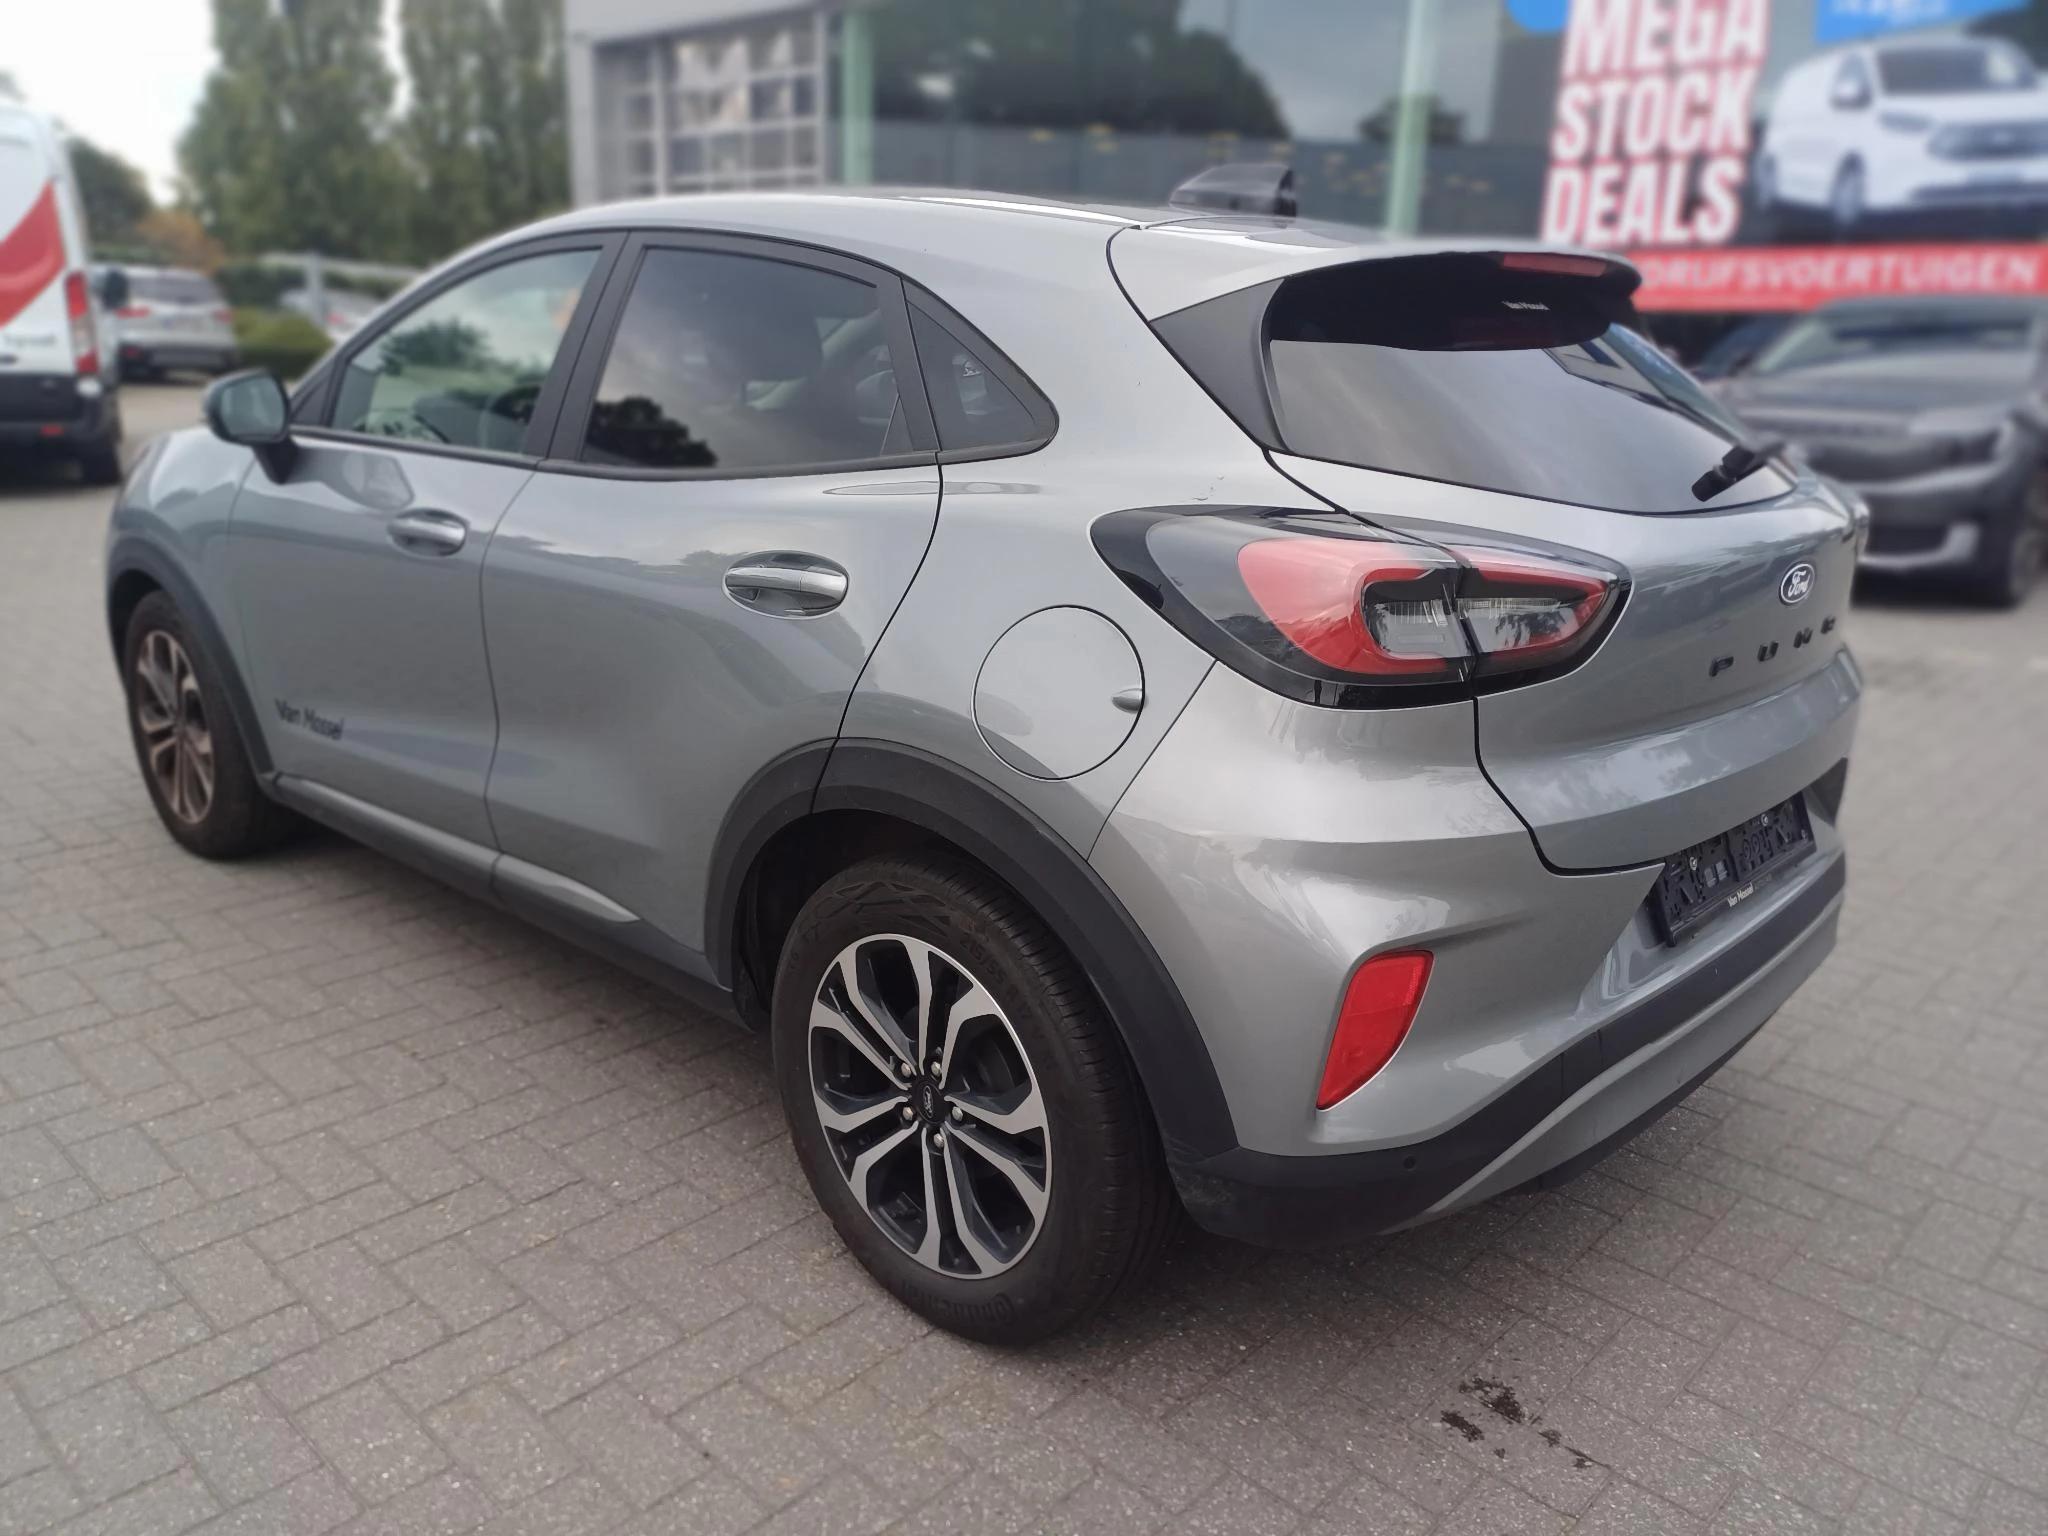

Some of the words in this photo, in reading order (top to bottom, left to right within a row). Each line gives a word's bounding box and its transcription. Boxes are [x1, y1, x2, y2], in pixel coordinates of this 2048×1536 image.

[1563, 0, 1766, 77] MEGA
[1553, 68, 1756, 160] STOCK
[1543, 156, 1745, 243] DEALS
[1641, 254, 2038, 289] DRIJFSVOERTUIGEN
[274, 697, 301, 724] Van
[303, 706, 345, 741] Mossel
[1728, 895, 1738, 907] Van
[1737, 882, 1754, 902] Mossel
